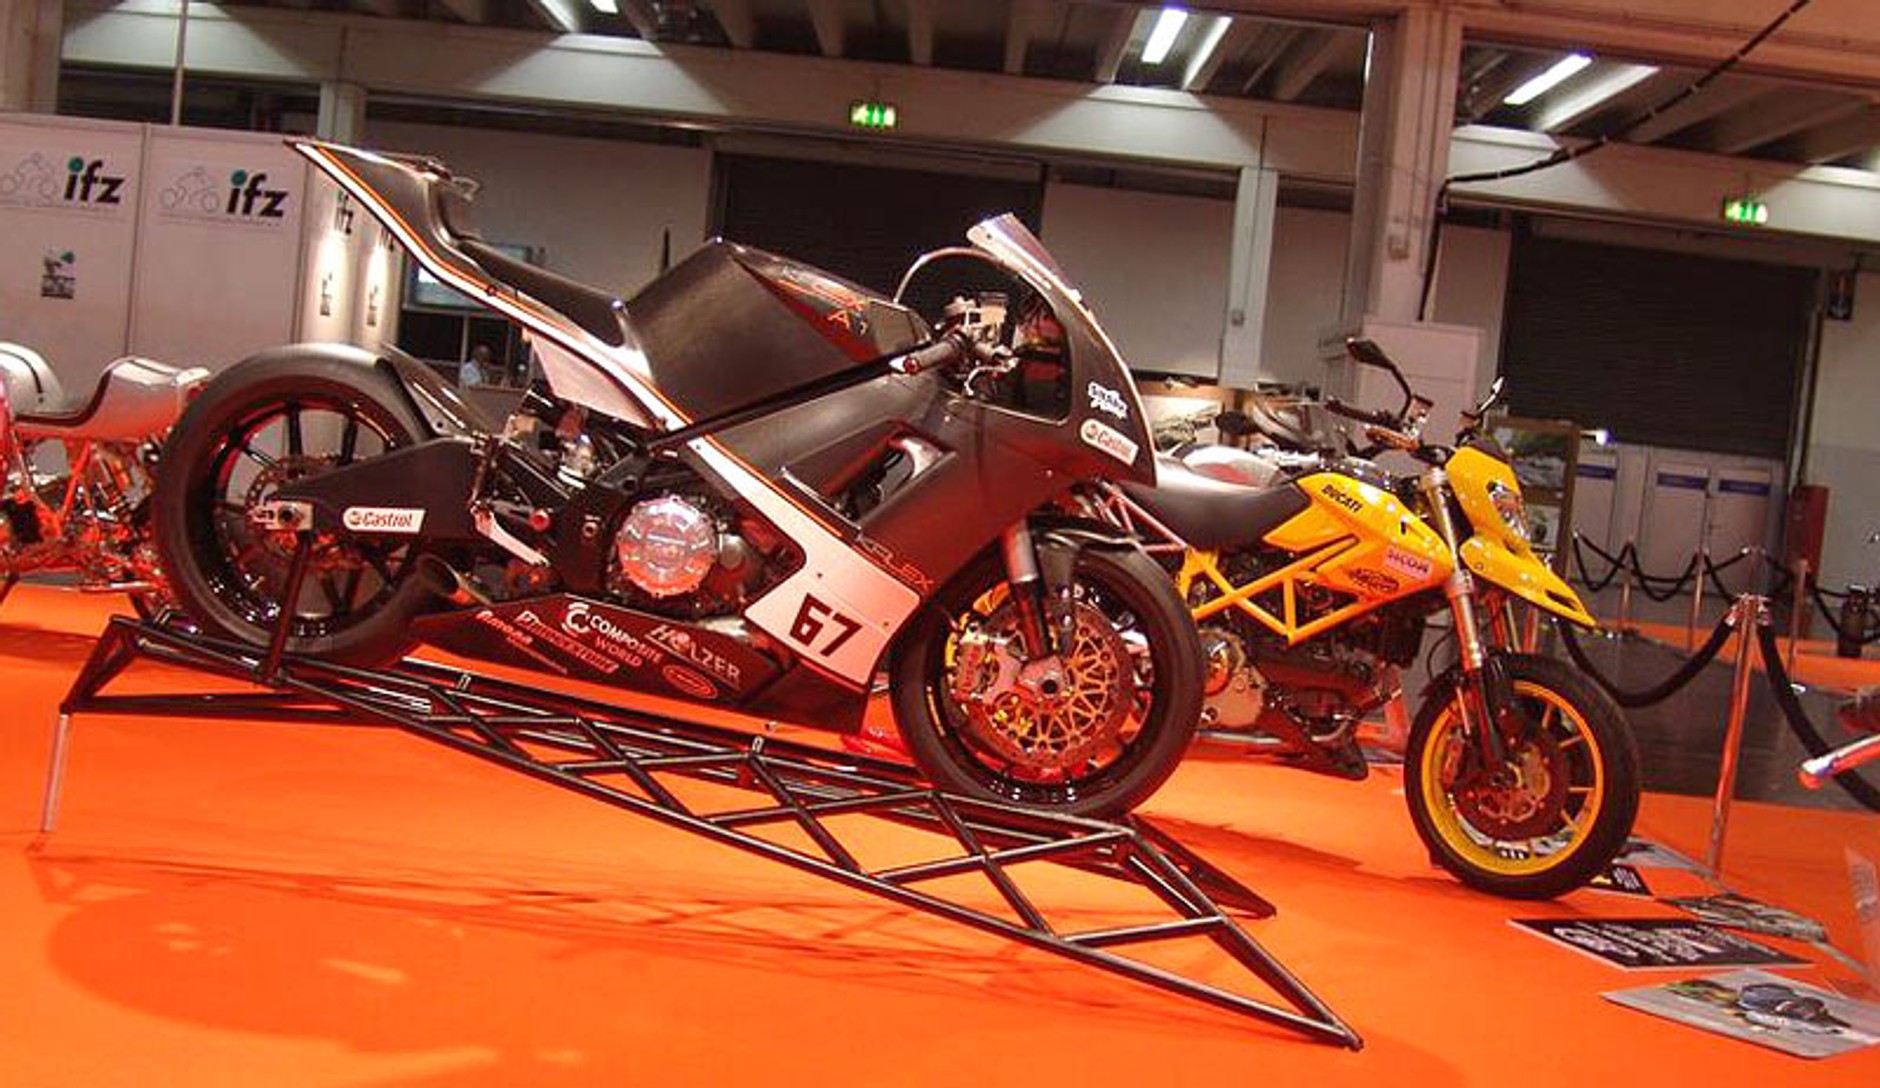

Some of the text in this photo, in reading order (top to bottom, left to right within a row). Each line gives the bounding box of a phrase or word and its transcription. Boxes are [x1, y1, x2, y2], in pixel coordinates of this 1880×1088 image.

[63, 156, 125, 204] ifz
[226, 169, 288, 218] ifz
[362, 510, 413, 528] Castrol
[1321, 484, 1362, 512] DUCATI
[589, 615, 664, 664] COMPOSITE
[789, 592, 863, 657] 67
[595, 635, 643, 667] WORLD
[651, 624, 741, 680] HOLZER
